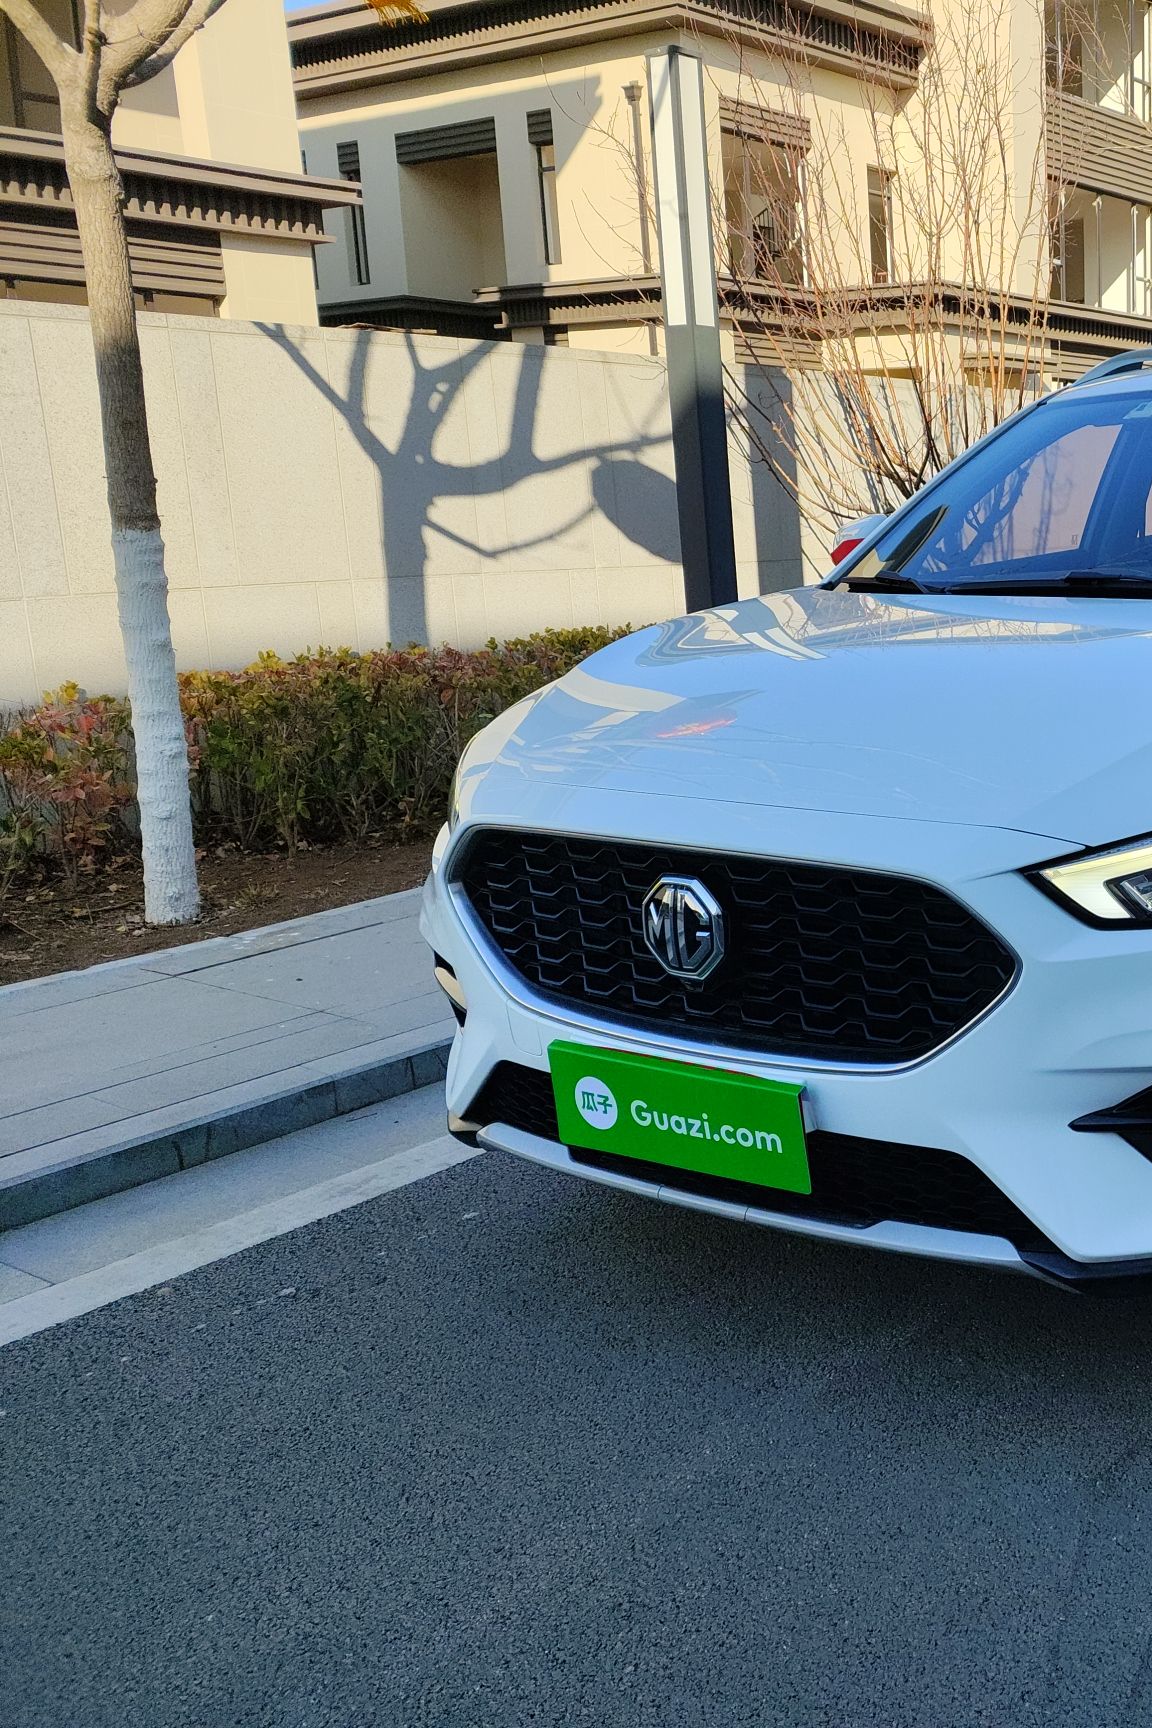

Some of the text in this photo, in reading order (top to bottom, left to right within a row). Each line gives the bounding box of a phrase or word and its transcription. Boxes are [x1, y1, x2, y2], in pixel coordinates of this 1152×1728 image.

[647, 884, 712, 970] MG
[581, 1090, 613, 1115] 瓜子
[630, 1100, 783, 1153] Guazi.com
